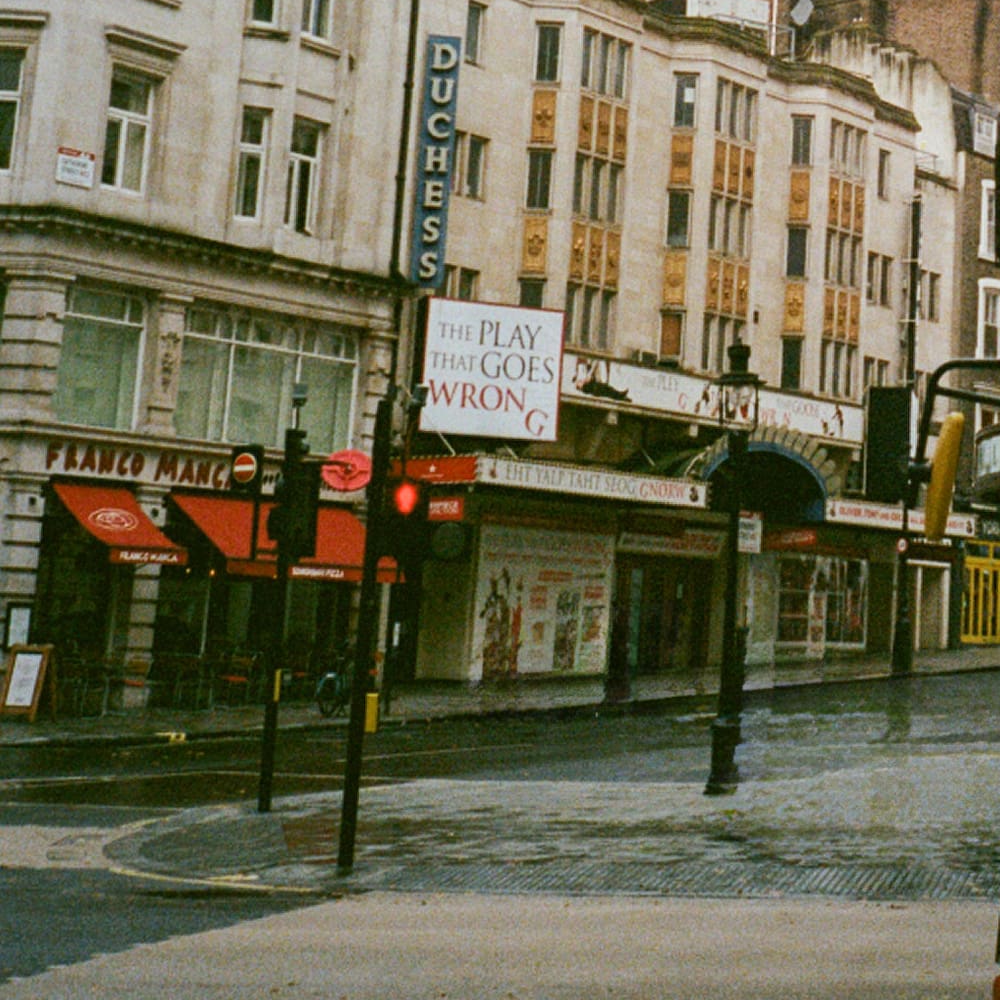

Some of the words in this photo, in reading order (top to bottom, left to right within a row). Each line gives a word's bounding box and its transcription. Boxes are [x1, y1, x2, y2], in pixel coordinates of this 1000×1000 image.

[419, 42, 458, 279] DUCHESS
[439, 321, 473, 341] THE
[479, 319, 542, 350] PLAY
[431, 351, 477, 372] THAT
[480, 351, 555, 384] GOES
[429, 379, 549, 437] WRONG
[46, 446, 145, 478] FRANCO
[154, 458, 231, 489] MANC
